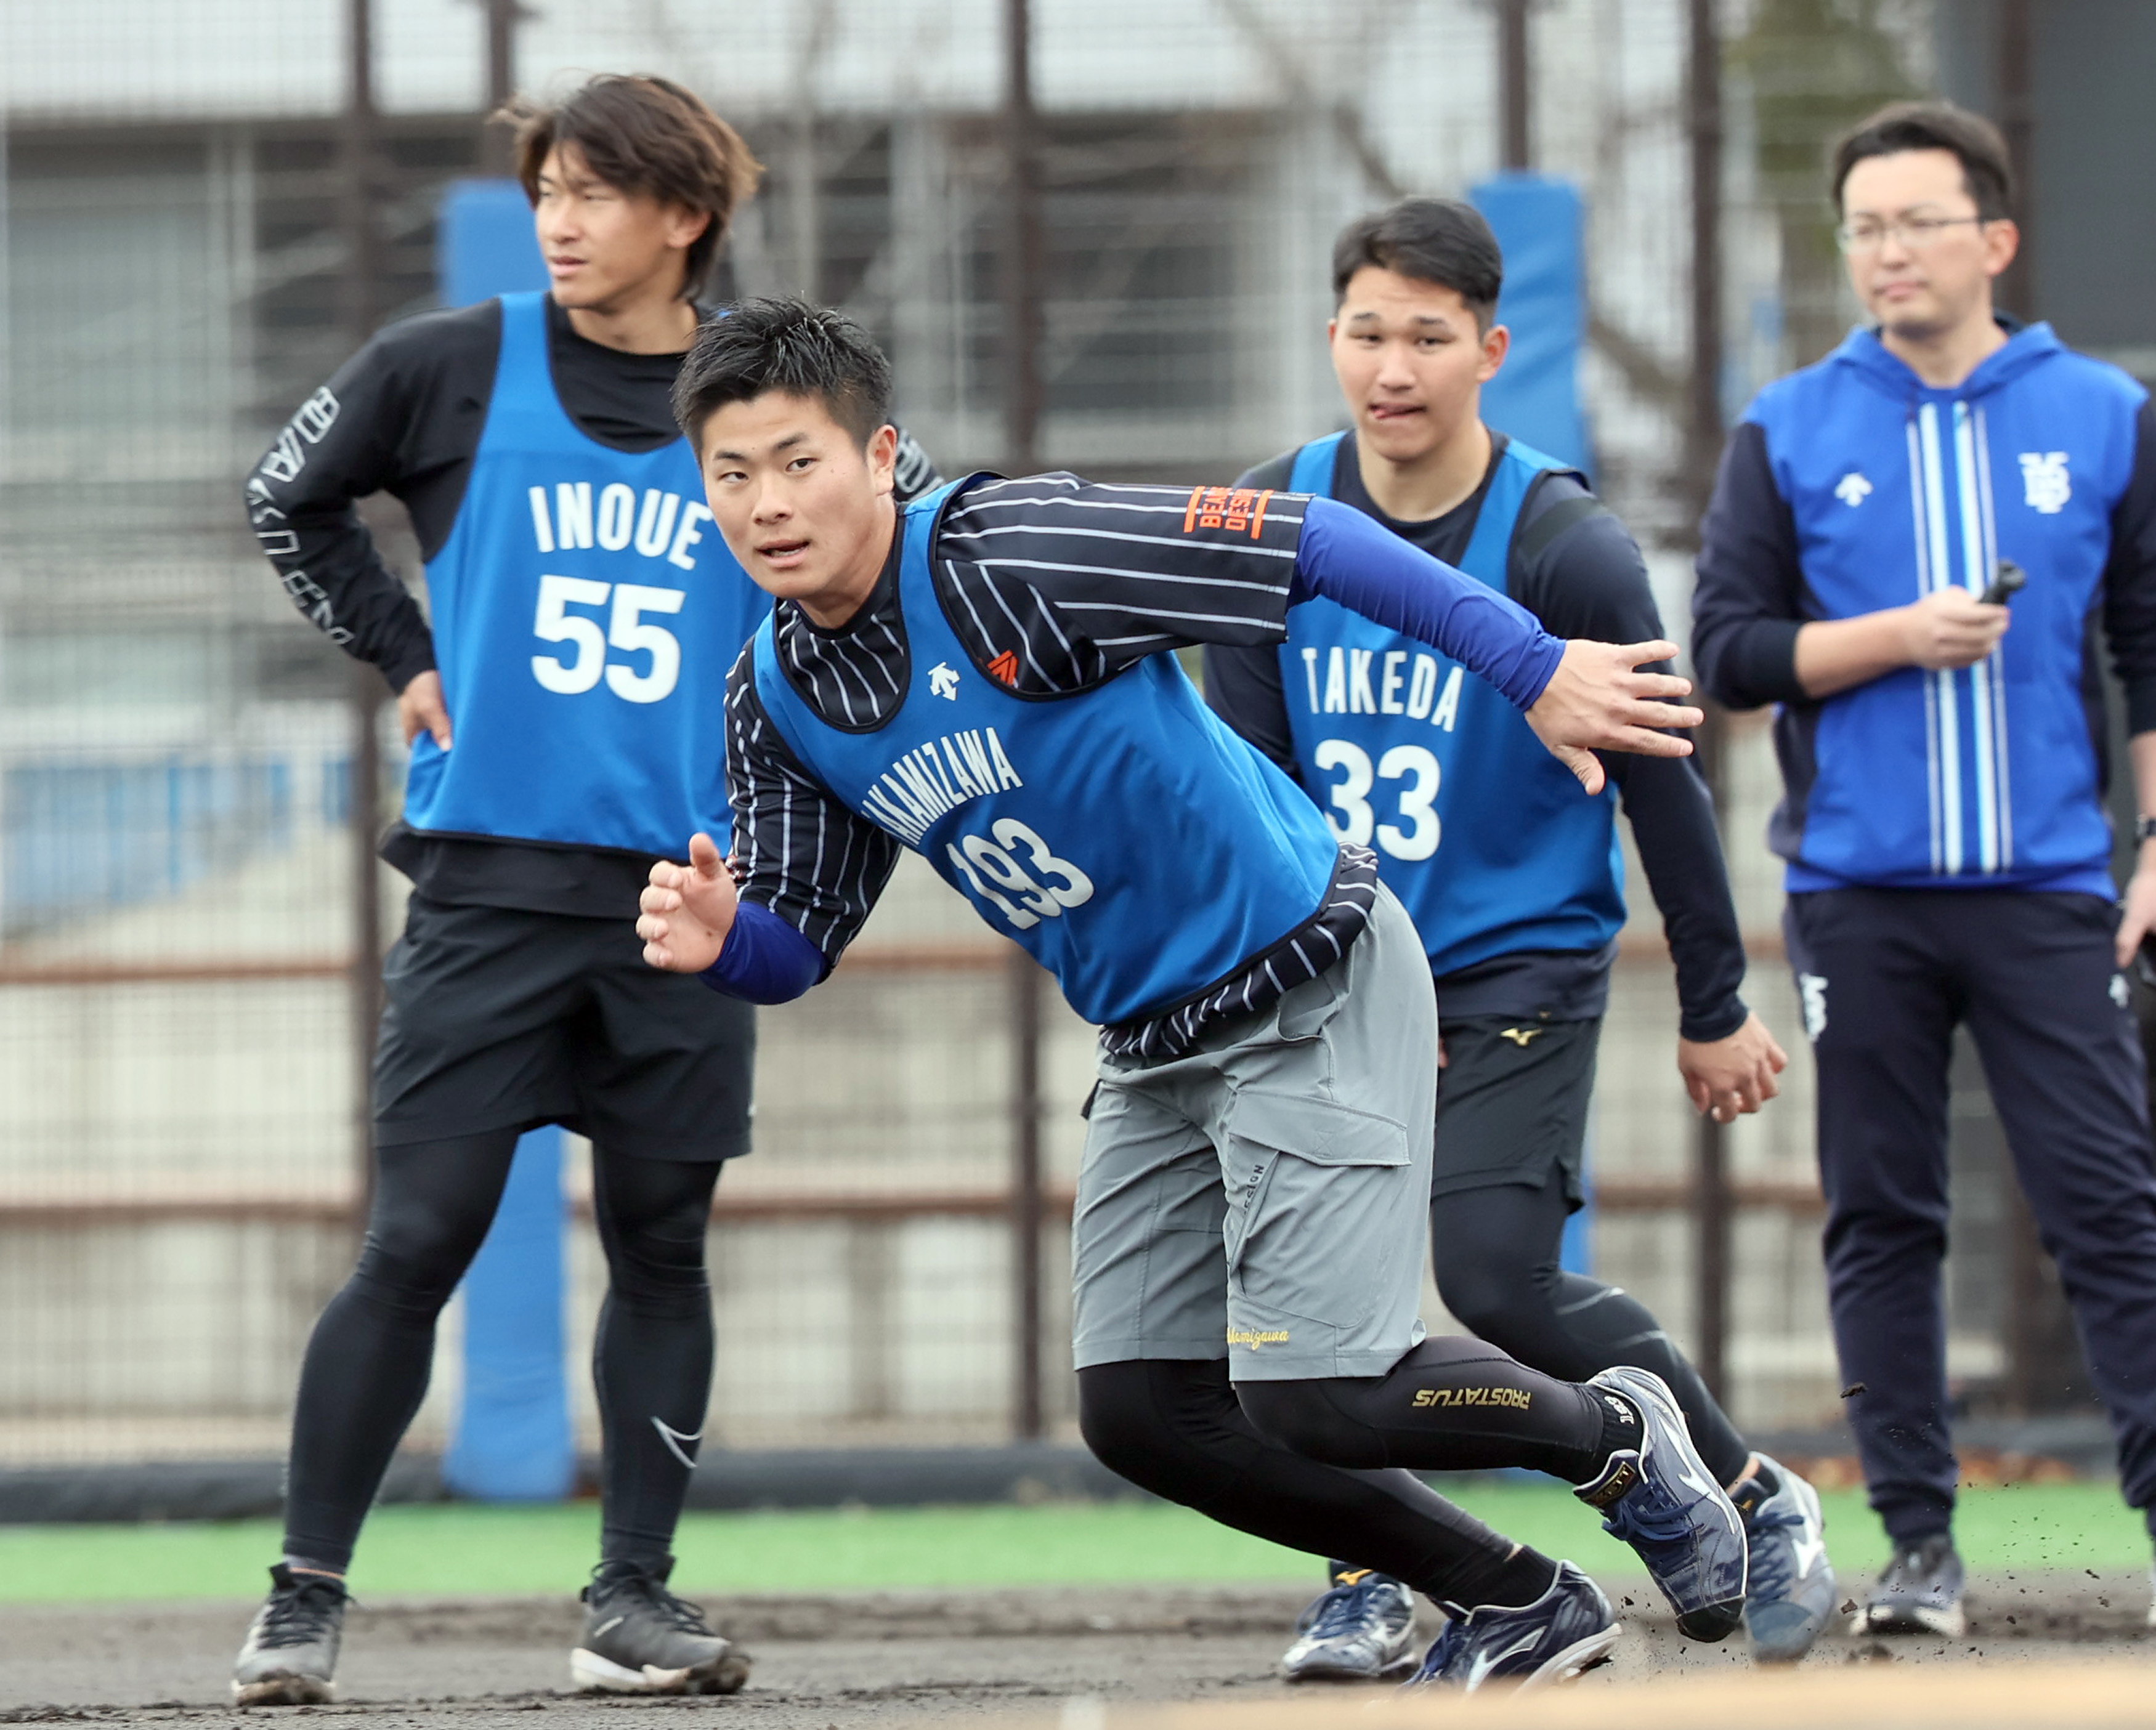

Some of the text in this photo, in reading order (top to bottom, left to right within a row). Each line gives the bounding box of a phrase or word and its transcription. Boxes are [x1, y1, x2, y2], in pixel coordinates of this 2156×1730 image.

[529, 482, 713, 570] INOUE
[531, 574, 686, 703] 55
[1301, 646, 1464, 732] TAKEDA
[861, 727, 1024, 846] AKAMIZAWA
[1315, 739, 1441, 861] 33
[946, 818, 1094, 929] 193
[1412, 1388, 1531, 1410] PROSTATUS
